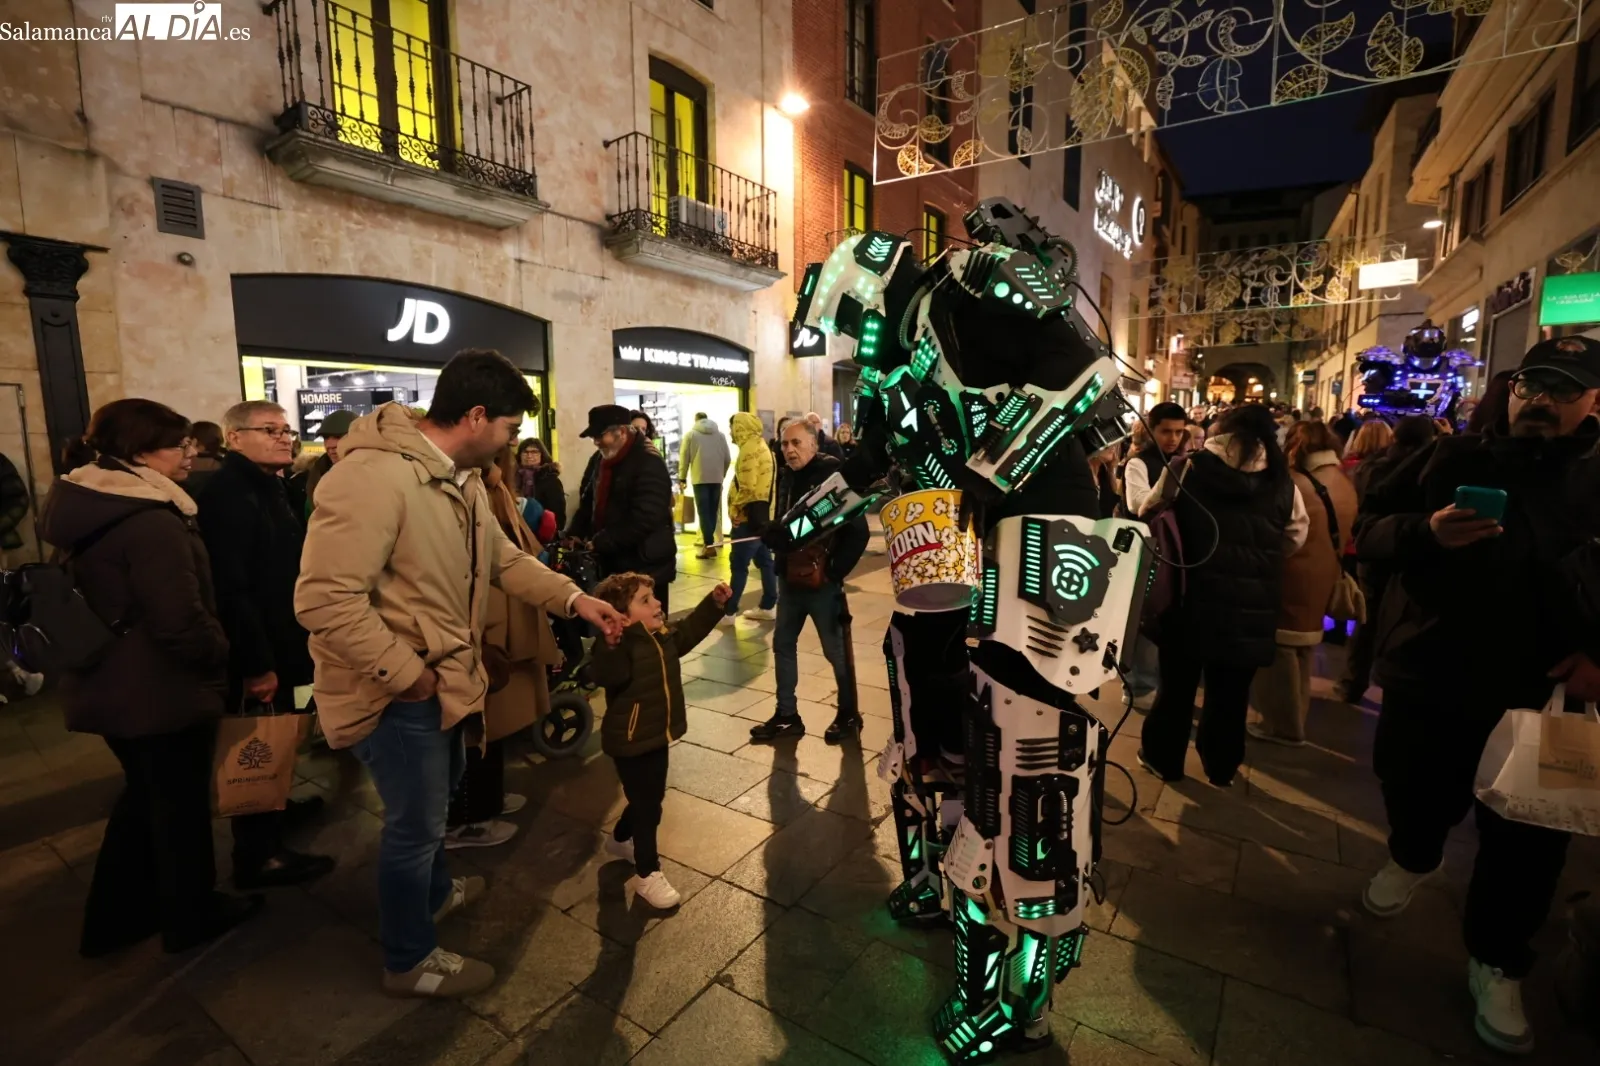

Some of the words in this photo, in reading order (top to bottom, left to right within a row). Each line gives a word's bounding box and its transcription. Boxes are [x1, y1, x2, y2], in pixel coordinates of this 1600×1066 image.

[387, 298, 450, 345] JD
[643, 347, 677, 366] KING
[301, 393, 342, 404] HOMBRE
[889, 521, 938, 564] CORN
